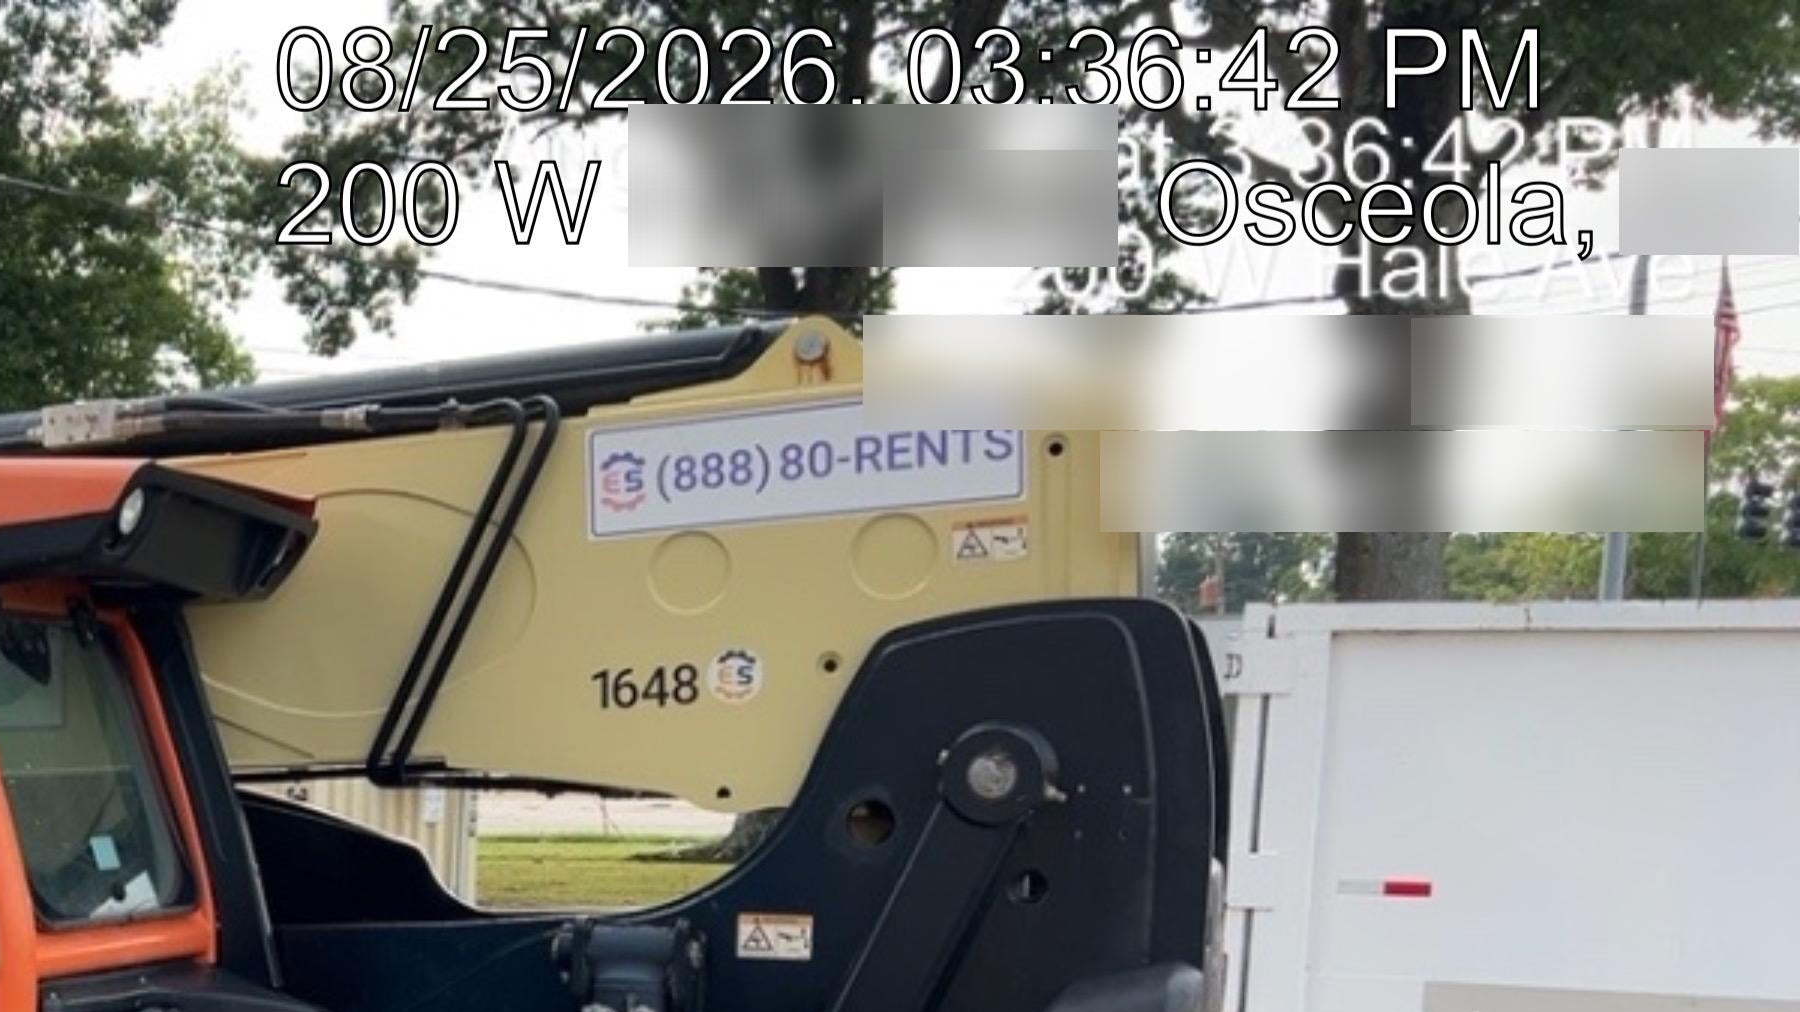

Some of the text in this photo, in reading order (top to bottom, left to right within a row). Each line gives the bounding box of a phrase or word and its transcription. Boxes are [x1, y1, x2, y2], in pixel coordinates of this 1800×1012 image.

[656, 444, 771, 504] (888)
[780, 430, 1014, 482] 80-RENTS
[591, 662, 699, 710] 1648
